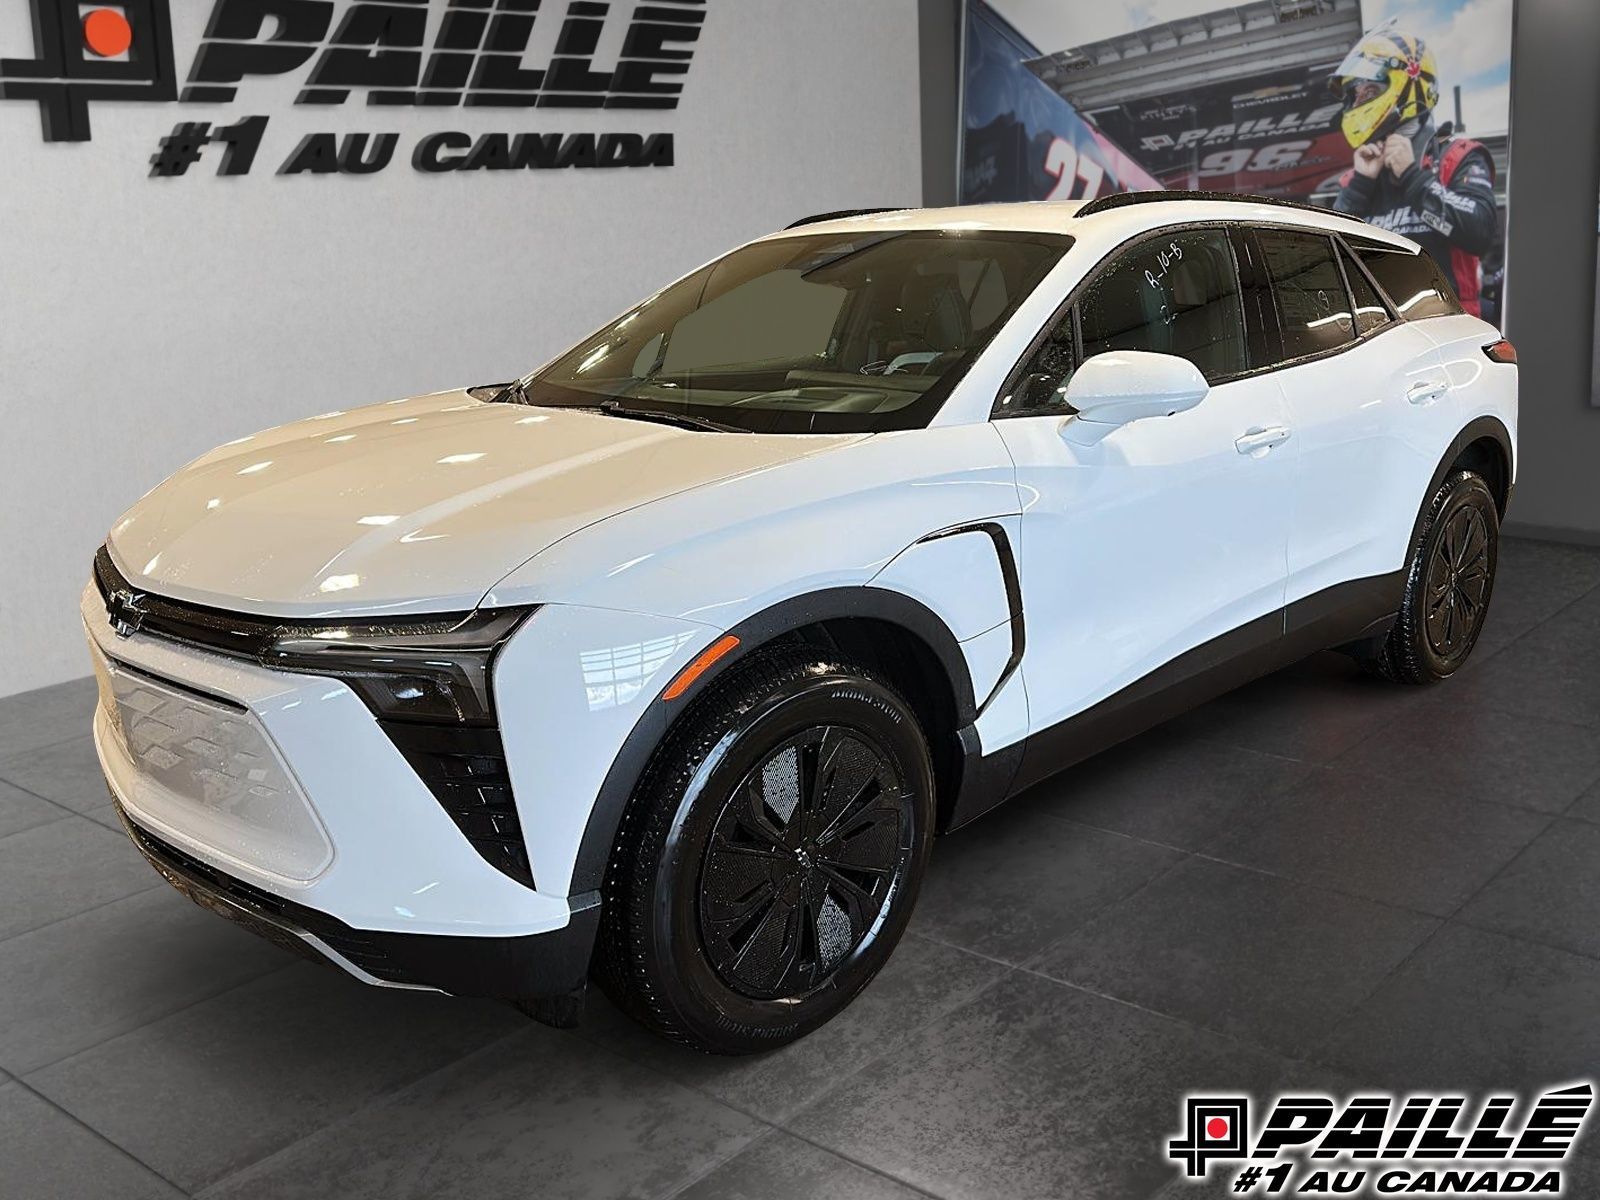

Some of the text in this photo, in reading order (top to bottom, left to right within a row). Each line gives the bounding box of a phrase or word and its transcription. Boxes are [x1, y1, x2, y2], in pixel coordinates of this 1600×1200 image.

[1233, 91, 1308, 110] CHEVROLET
[147, 115, 675, 178] #1 AU CANADA
[1202, 136, 1233, 147] AU
[1237, 121, 1331, 141] CANADA
[1201, 140, 1312, 177] 96
